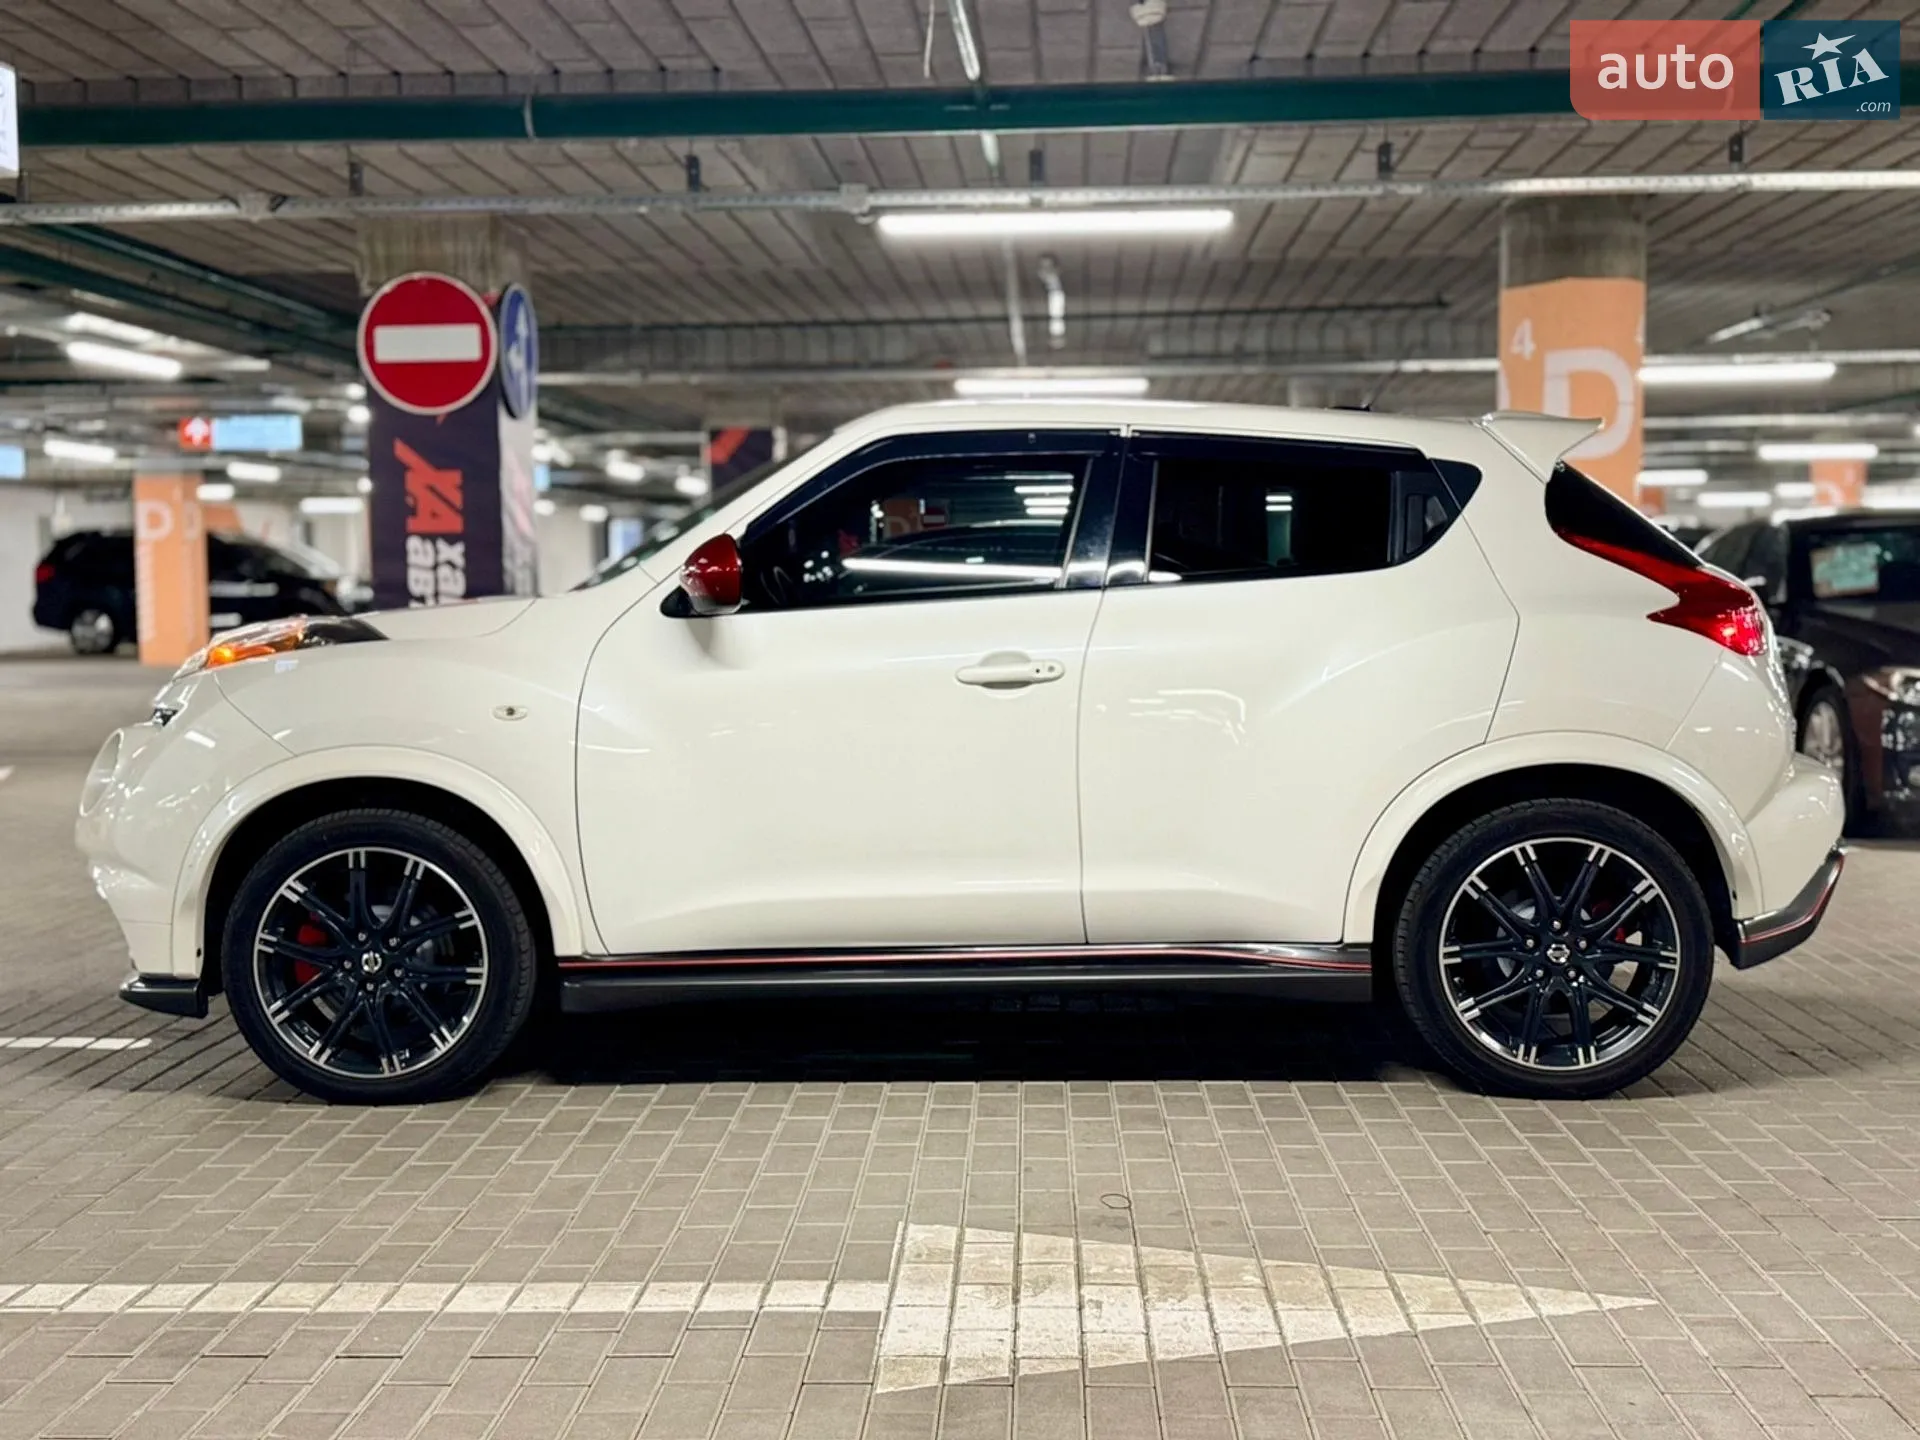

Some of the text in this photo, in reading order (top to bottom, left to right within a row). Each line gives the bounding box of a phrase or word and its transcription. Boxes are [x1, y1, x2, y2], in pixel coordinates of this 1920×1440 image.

[1510, 317, 1536, 361] 4
[1542, 346, 1634, 461] D
[136, 500, 175, 542] D
